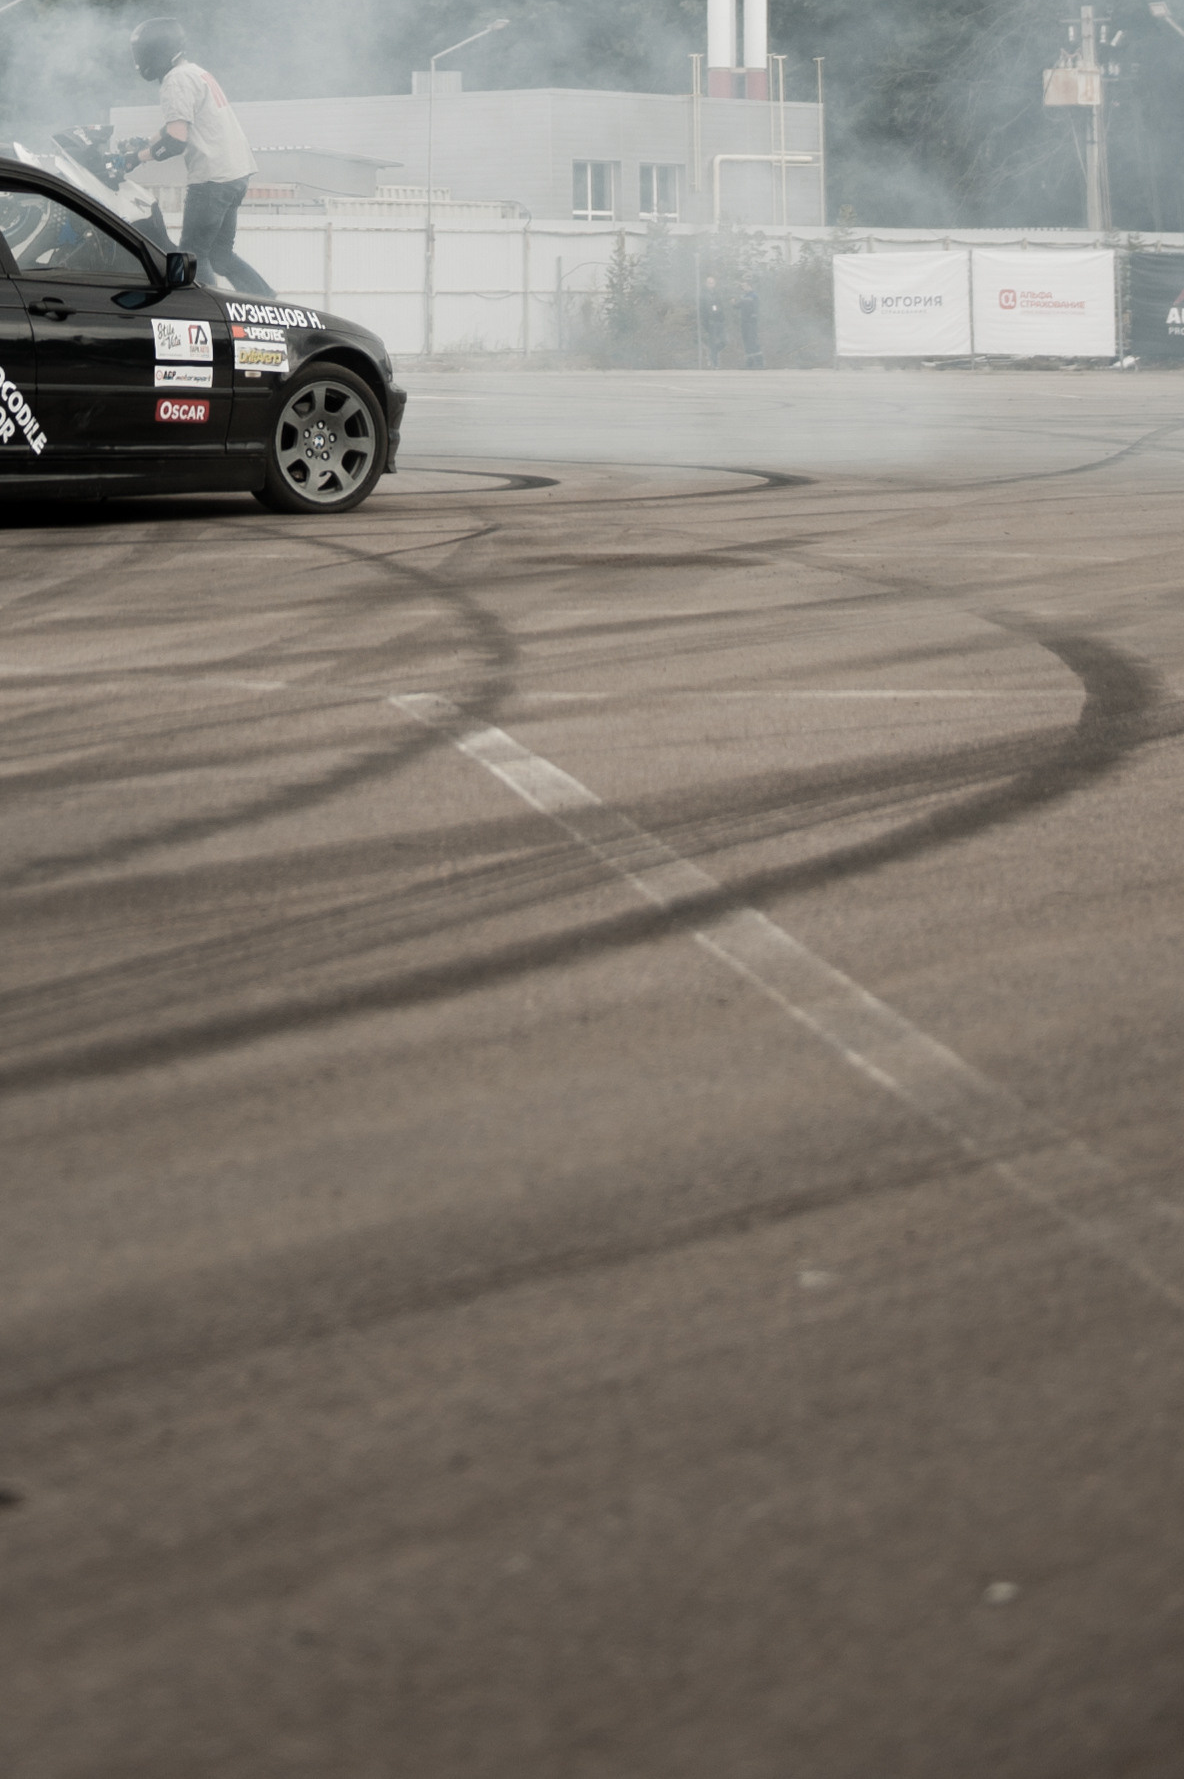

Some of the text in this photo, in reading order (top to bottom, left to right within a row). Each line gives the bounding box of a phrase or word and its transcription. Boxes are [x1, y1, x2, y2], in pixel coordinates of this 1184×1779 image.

[881, 295, 943, 308] ЮГОРИЯ
[225, 302, 326, 330] КУЗНЕЦОВ Н.
[159, 400, 206, 421] OSCAR
